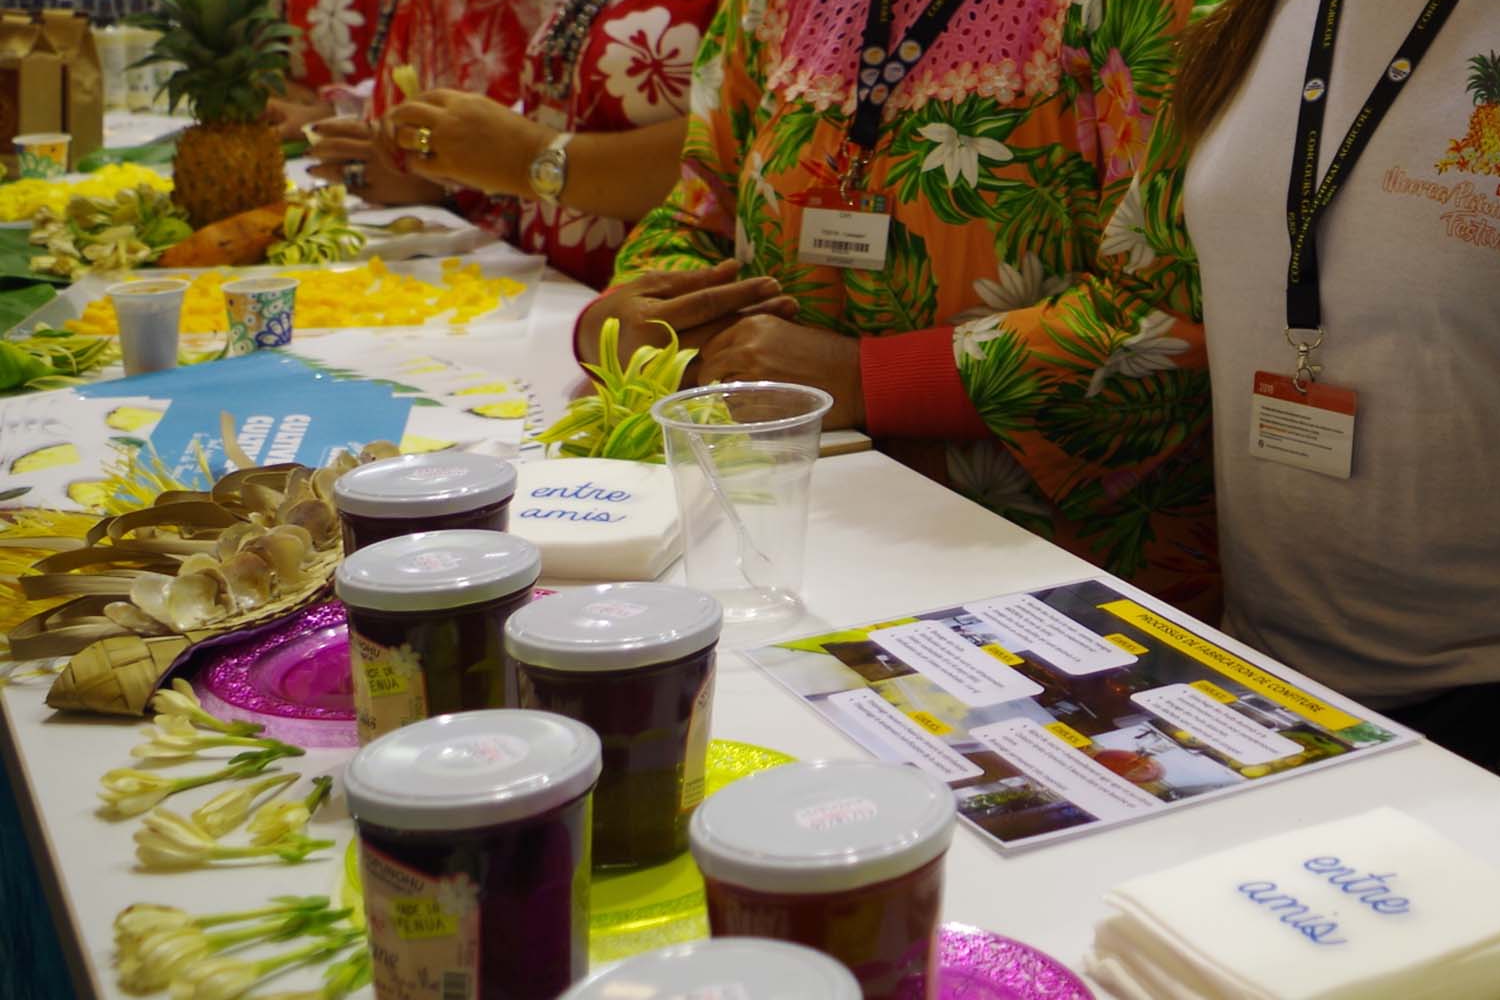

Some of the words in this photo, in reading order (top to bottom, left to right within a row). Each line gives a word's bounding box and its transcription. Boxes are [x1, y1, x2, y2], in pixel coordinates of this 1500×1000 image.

[520, 507, 627, 523] amis
[531, 481, 632, 503] entre
[1196, 643, 1255, 678] FABRICATION
[1267, 681, 1326, 713] CONFITURE
[1237, 879, 1347, 946] amis
[1302, 854, 1411, 917] entre
